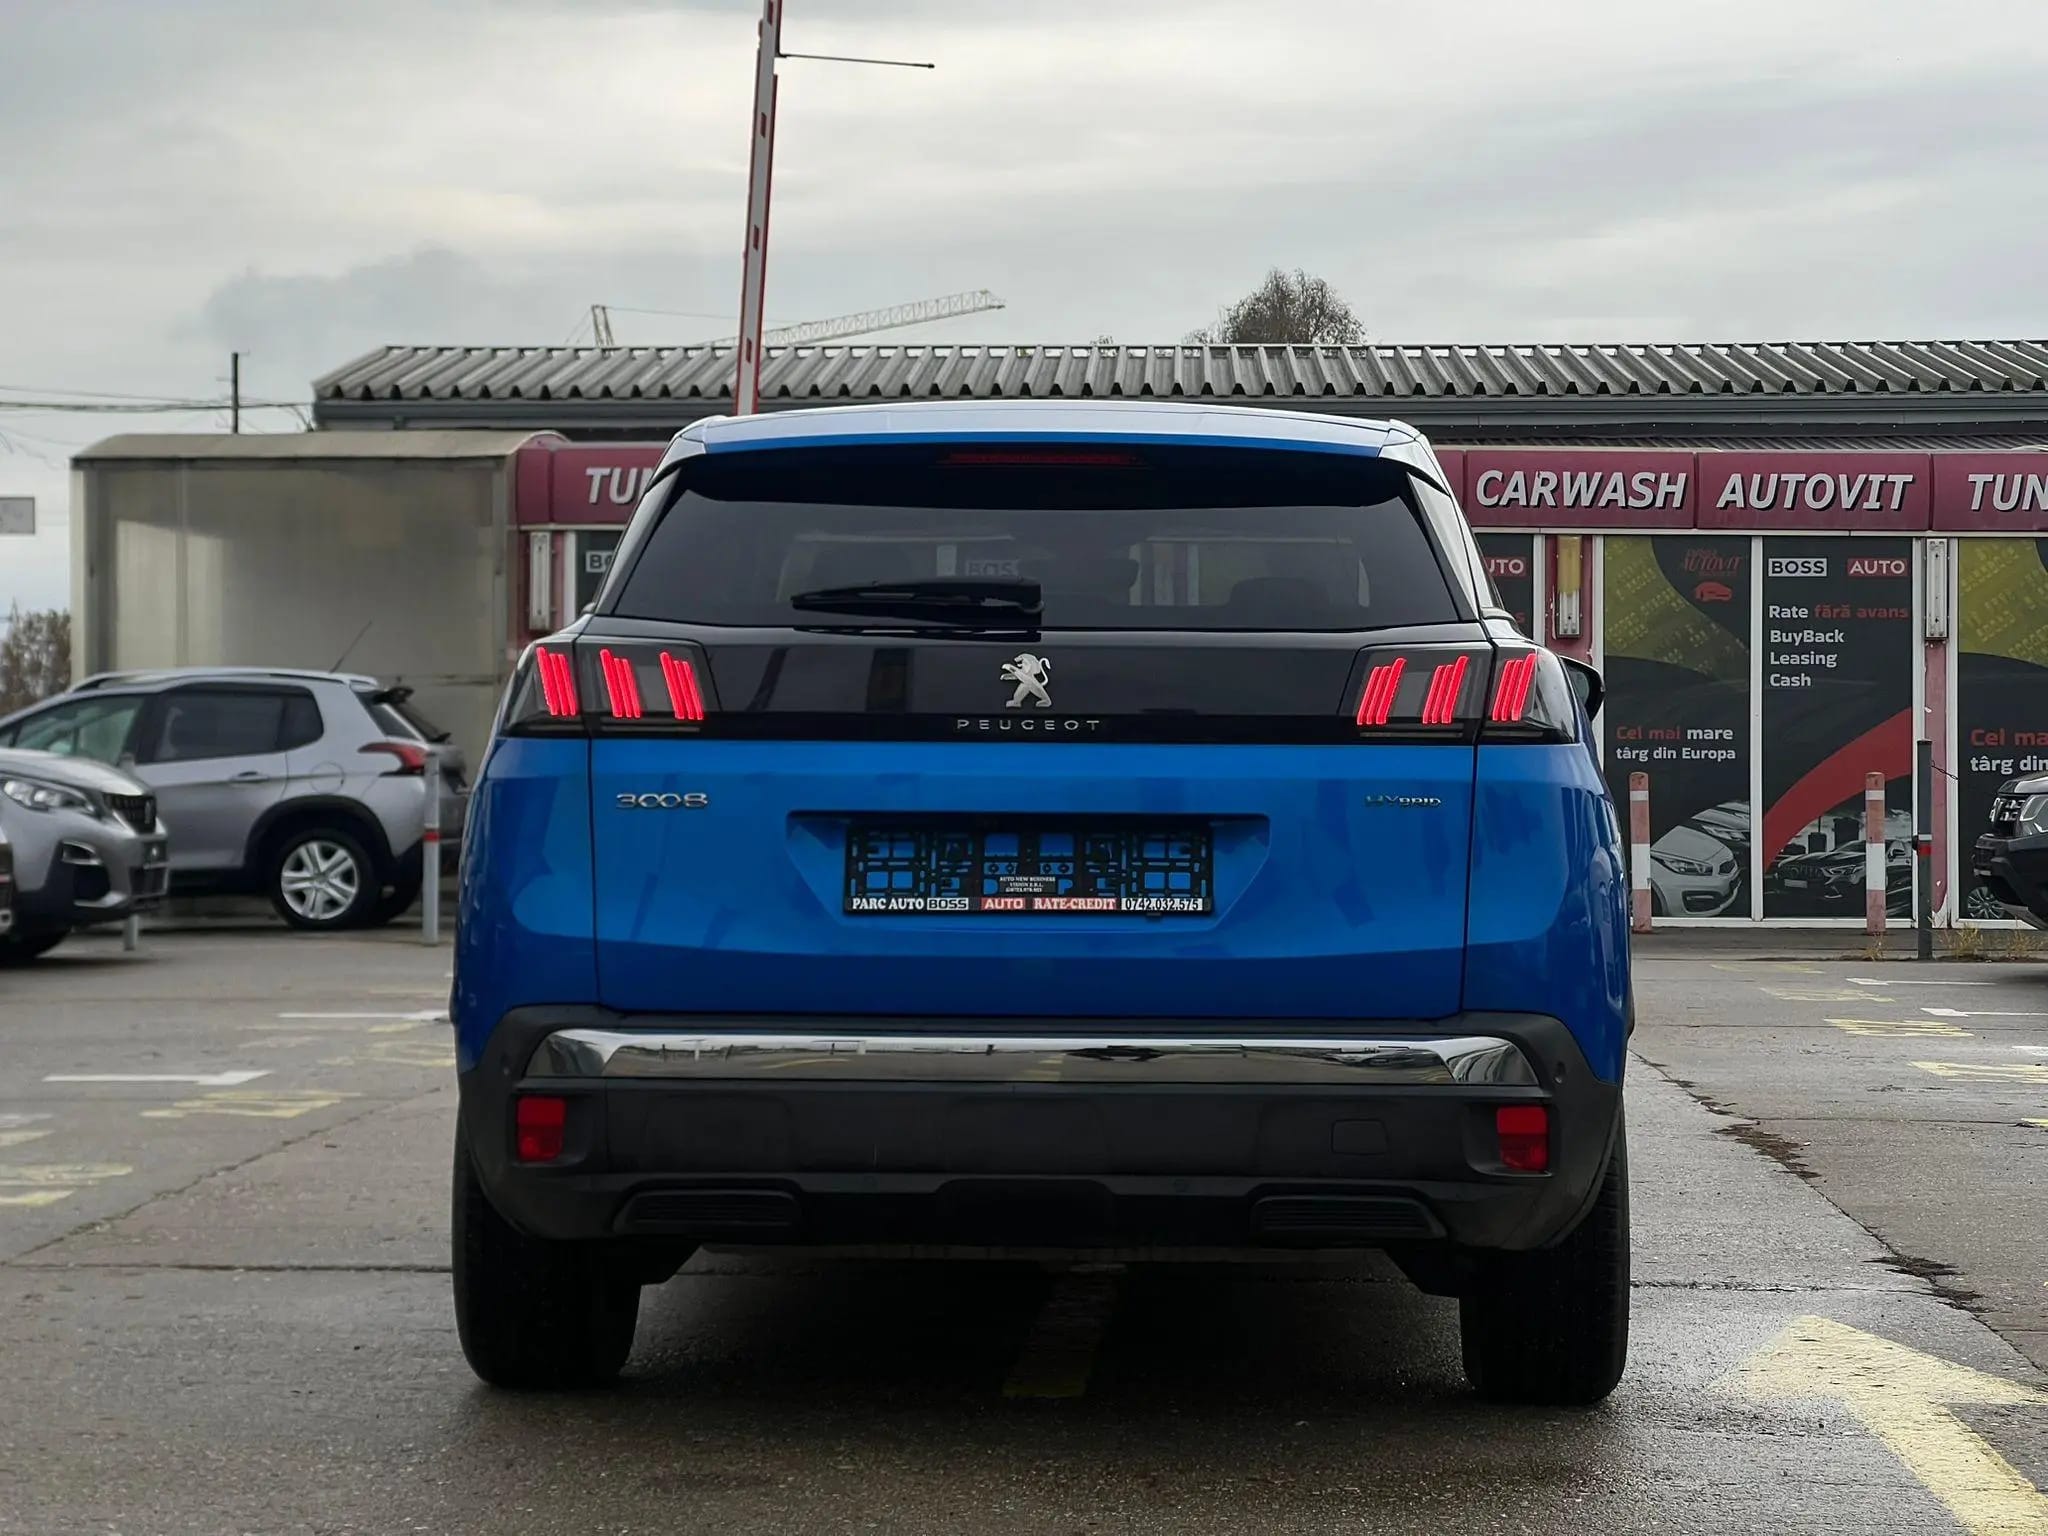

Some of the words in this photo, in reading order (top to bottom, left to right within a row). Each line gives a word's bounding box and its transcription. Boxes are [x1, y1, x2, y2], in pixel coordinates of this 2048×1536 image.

[1475, 468, 1688, 510] CARWASH
[1715, 472, 1914, 511] AUTOVIT
[1770, 559, 1826, 575] BOSS
[1849, 560, 1906, 575] AUTO
[1769, 605, 1809, 619] Rate
[1856, 607, 1908, 619] avans
[1770, 629, 1845, 646] BuyBack
[1770, 651, 1838, 668] Leasing
[1769, 673, 1812, 687] Cash
[956, 719, 1101, 731] PEUGEOT
[1616, 725, 1642, 740] Cel
[1648, 725, 1680, 740] mai
[1686, 728, 1734, 740] mare
[1971, 727, 2006, 747] Cel
[1616, 747, 1649, 762] târg
[1653, 747, 1677, 759] din
[1682, 748, 1736, 762] Europa
[1970, 755, 2014, 775] târg
[2019, 755, 2048, 771] din
[616, 793, 708, 808] 3008
[852, 897, 886, 910] PARC
[888, 898, 924, 910] AUTO
[927, 898, 968, 910] BOSS
[984, 898, 1024, 910] AUTO
